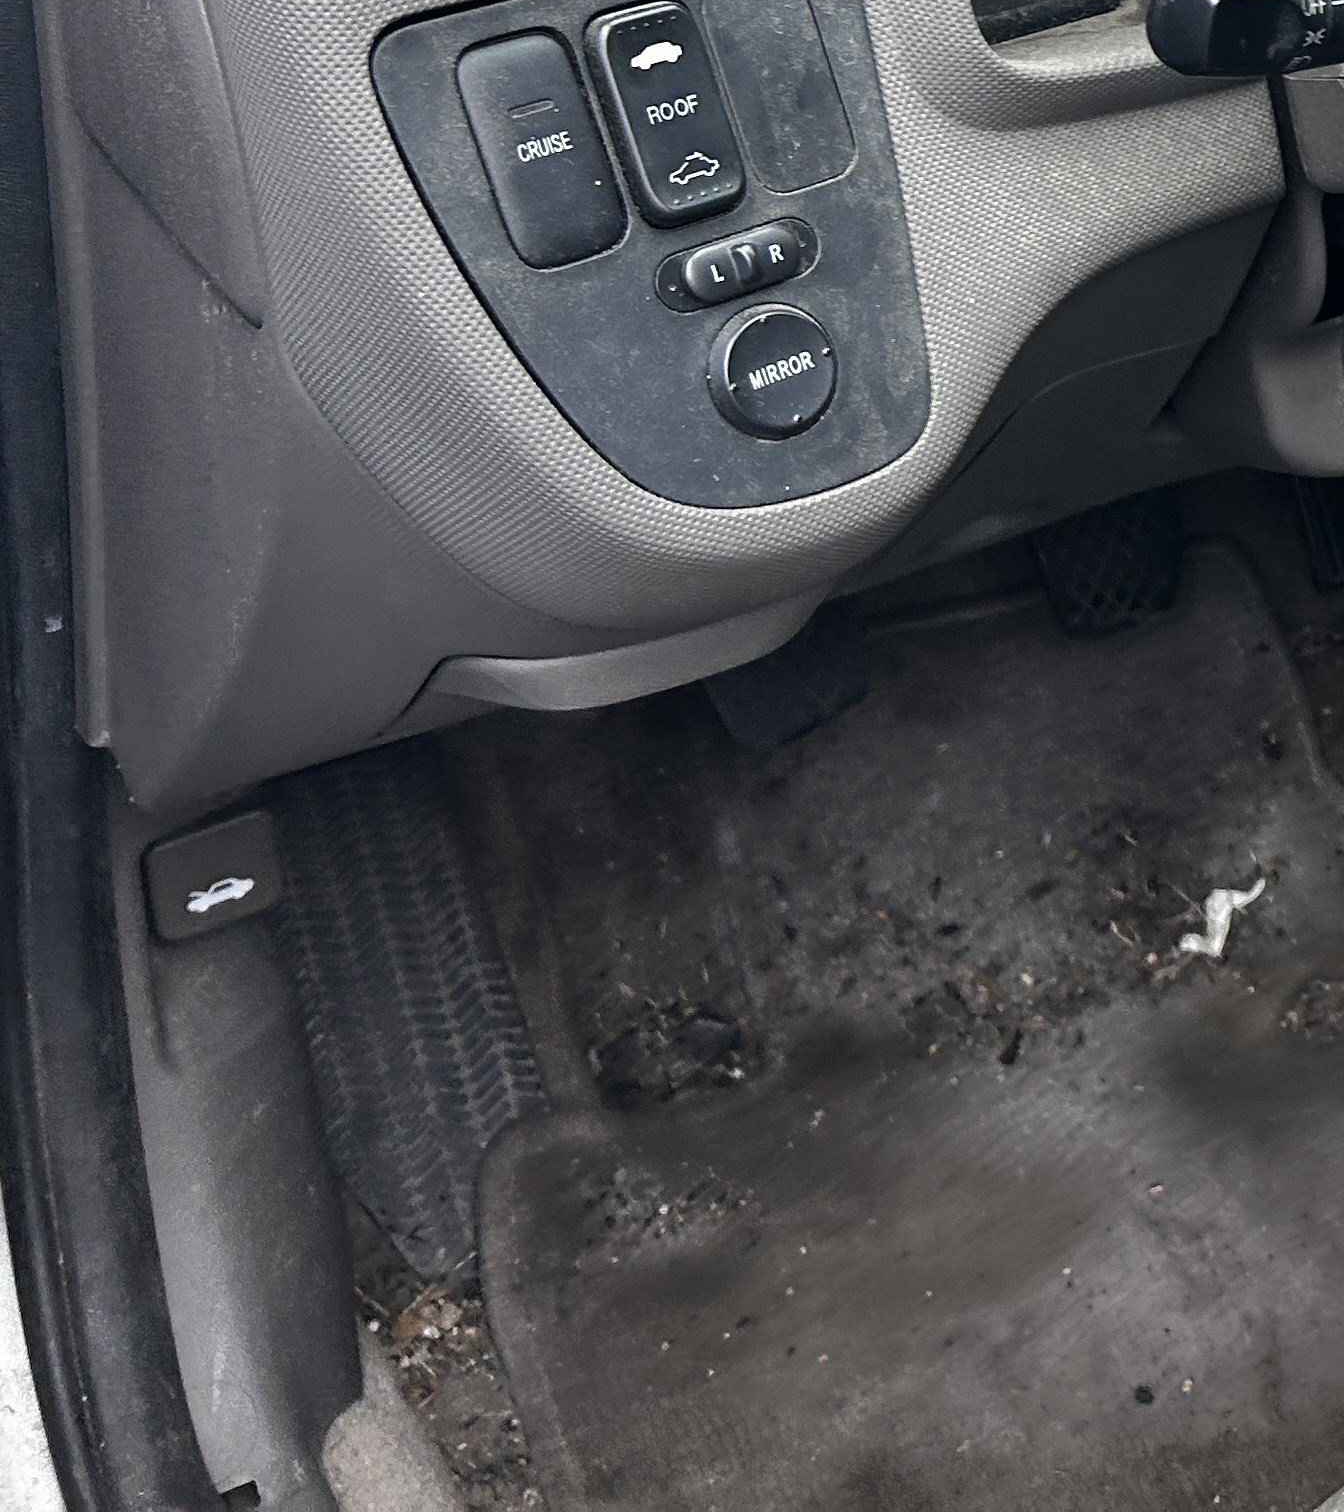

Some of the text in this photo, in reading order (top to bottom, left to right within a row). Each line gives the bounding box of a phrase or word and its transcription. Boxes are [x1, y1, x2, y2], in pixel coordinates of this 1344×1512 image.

[646, 93, 700, 126] ROOF
[517, 129, 574, 163] CRUISE
[710, 243, 785, 283] L R
[749, 350, 816, 390] MIRROR
